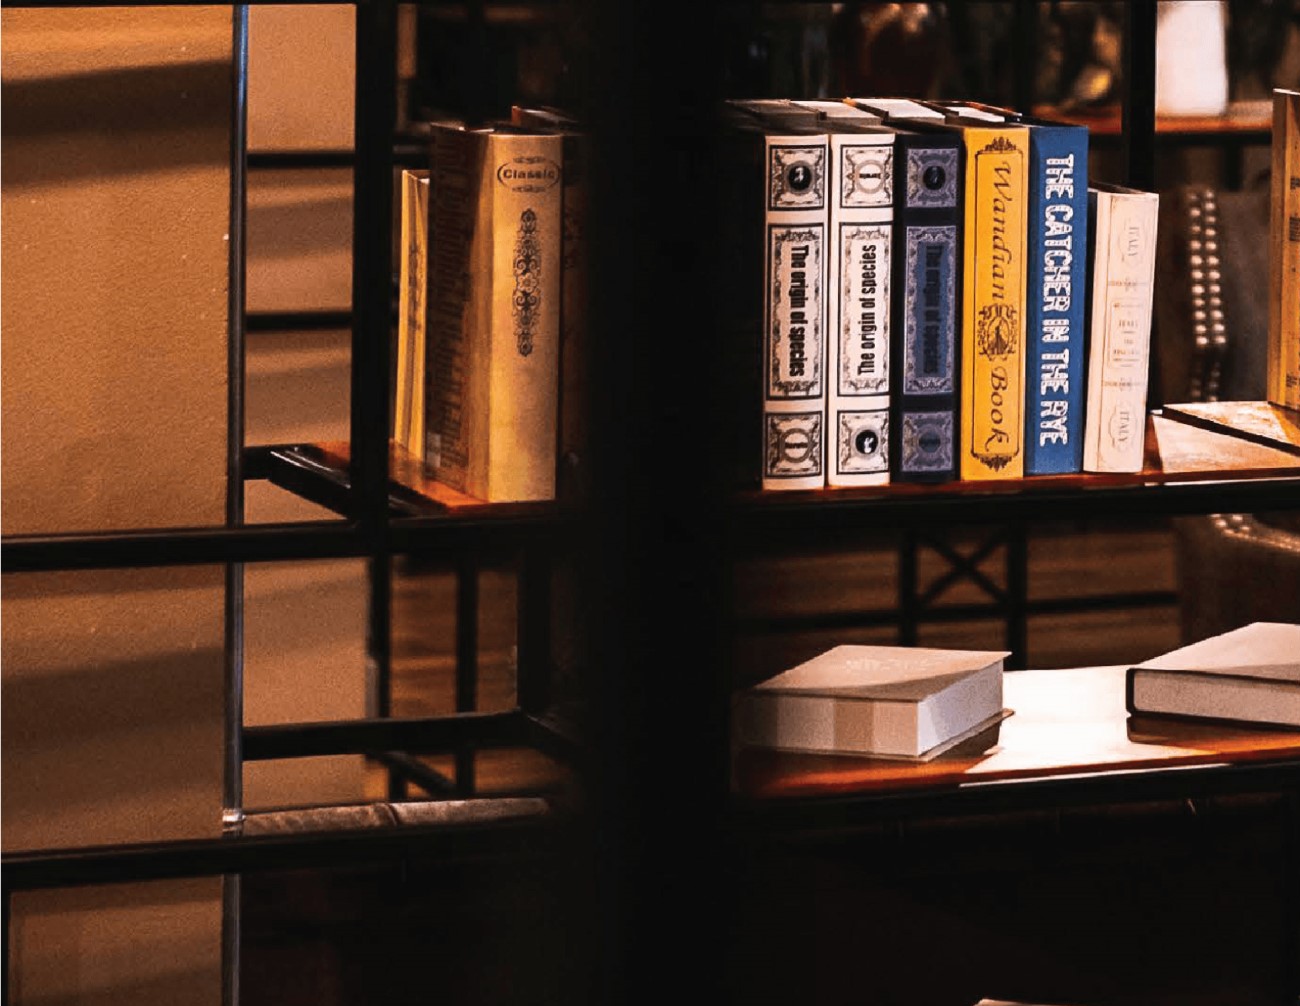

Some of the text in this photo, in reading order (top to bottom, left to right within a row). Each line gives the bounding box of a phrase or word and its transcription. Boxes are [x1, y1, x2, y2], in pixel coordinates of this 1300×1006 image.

[503, 168, 555, 181] Classic
[1128, 225, 1140, 258] ITALY
[789, 244, 809, 377] The origin of species
[857, 245, 878, 376] The origin of species
[1039, 153, 1074, 447] THE CATCHER IN THE RYE
[987, 367, 1010, 452] Book
[1118, 411, 1130, 444] ITALY
